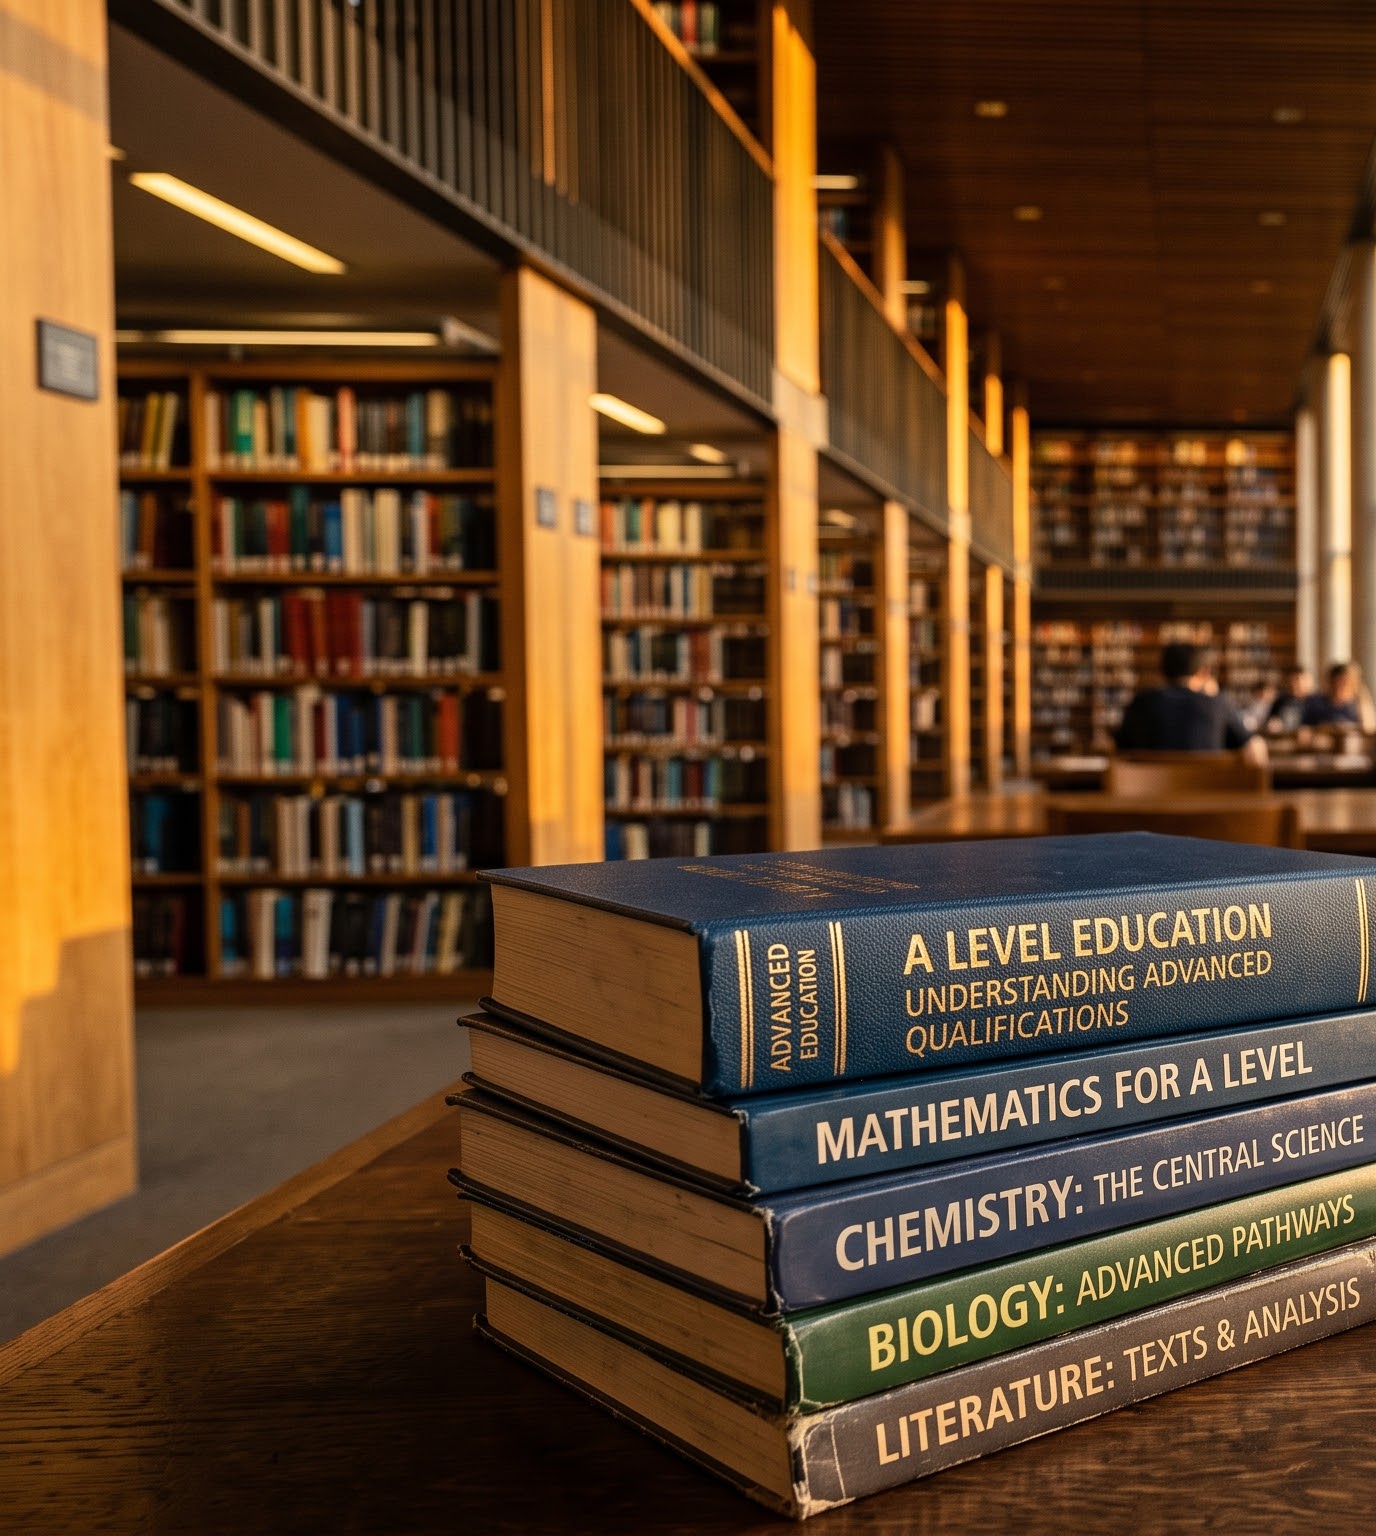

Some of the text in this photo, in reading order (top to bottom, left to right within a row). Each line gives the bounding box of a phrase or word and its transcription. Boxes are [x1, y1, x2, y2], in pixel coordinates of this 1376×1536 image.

[903, 902, 1273, 975] A LEVEL EDUCATION
[905, 949, 1273, 1018] UNDERSTANDING ADVANCED
[767, 943, 792, 1072] ADVANCED
[797, 949, 819, 1060] EDUCATION
[905, 1000, 1130, 1058] QUALIFICATIONS
[816, 1040, 1313, 1165] MATHEMATICS FOR A LEVEL
[835, 1114, 1365, 1272] CHEMISTRY: THE CENTRAL SCIENCE
[868, 1194, 1357, 1373] BIOLOGY: ADVANCED PATHWAYS
[876, 1276, 1361, 1466] LITERATURE: TEXTS & ANALYSIS
